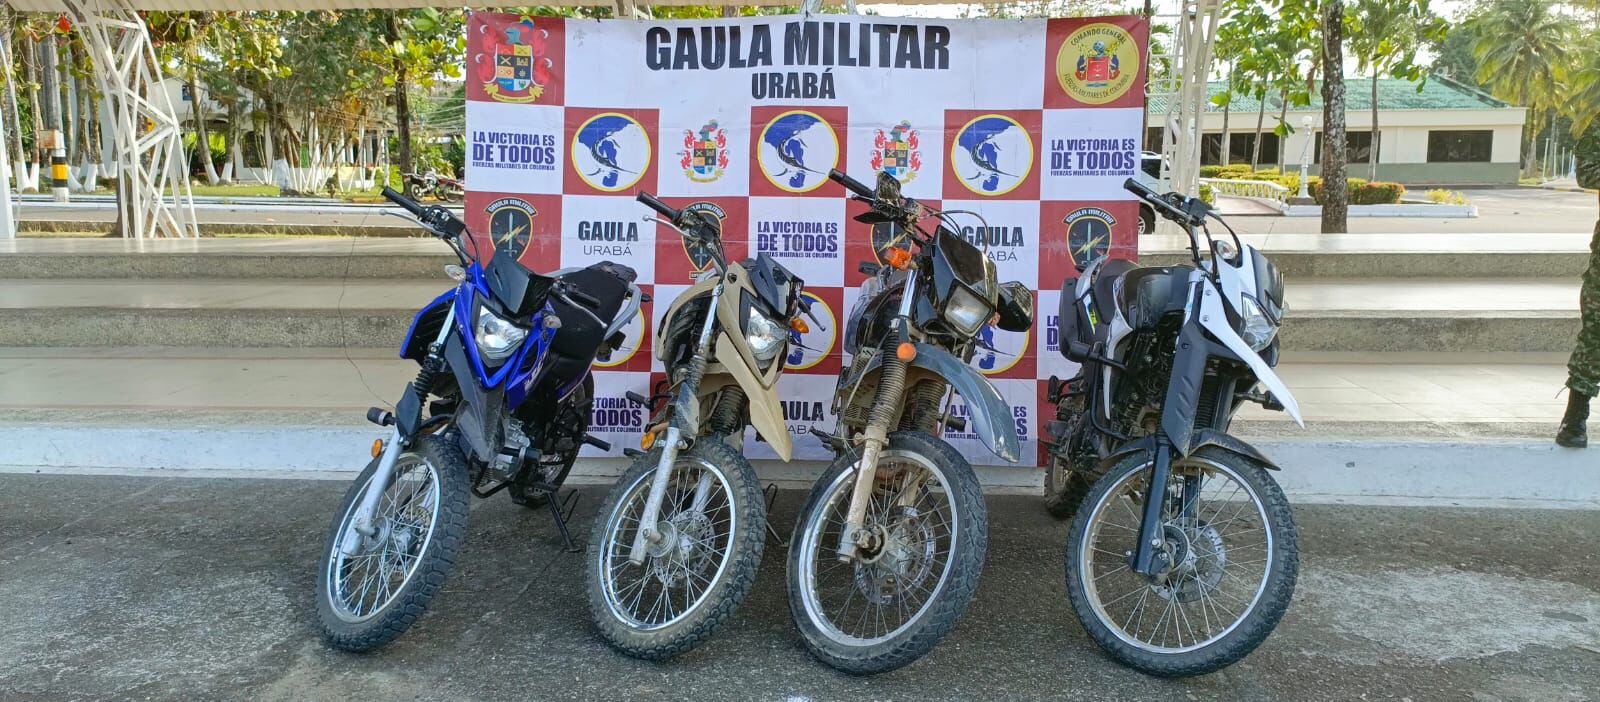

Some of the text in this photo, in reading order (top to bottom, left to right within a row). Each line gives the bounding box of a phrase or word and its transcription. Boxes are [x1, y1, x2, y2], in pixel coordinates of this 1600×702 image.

[1071, 28, 1126, 46] COMANDO GENERAL
[646, 21, 950, 70] GAULA MILITAR
[751, 68, 836, 99] URABÁ
[473, 131, 555, 146] LA VICTORIA ES
[1051, 138, 1135, 151] LA VICTORIA ES
[473, 143, 555, 165] DE TODOS
[1051, 151, 1135, 170] DE TODOS
[473, 161, 495, 169] FUERZAS
[487, 199, 535, 215] GAULA MILITAR
[1066, 209, 1114, 224] GAULA MILITAR
[578, 221, 639, 242] GAULA
[758, 222, 838, 234] LA VICTORIA ES
[758, 234, 838, 252] DE TODOS
[962, 226, 1024, 246] GAULA
[583, 242, 632, 256] URABÁ
[987, 248, 1018, 261] ABÁ
[592, 397, 627, 409] TORIA
[1013, 406, 1026, 417] ES
